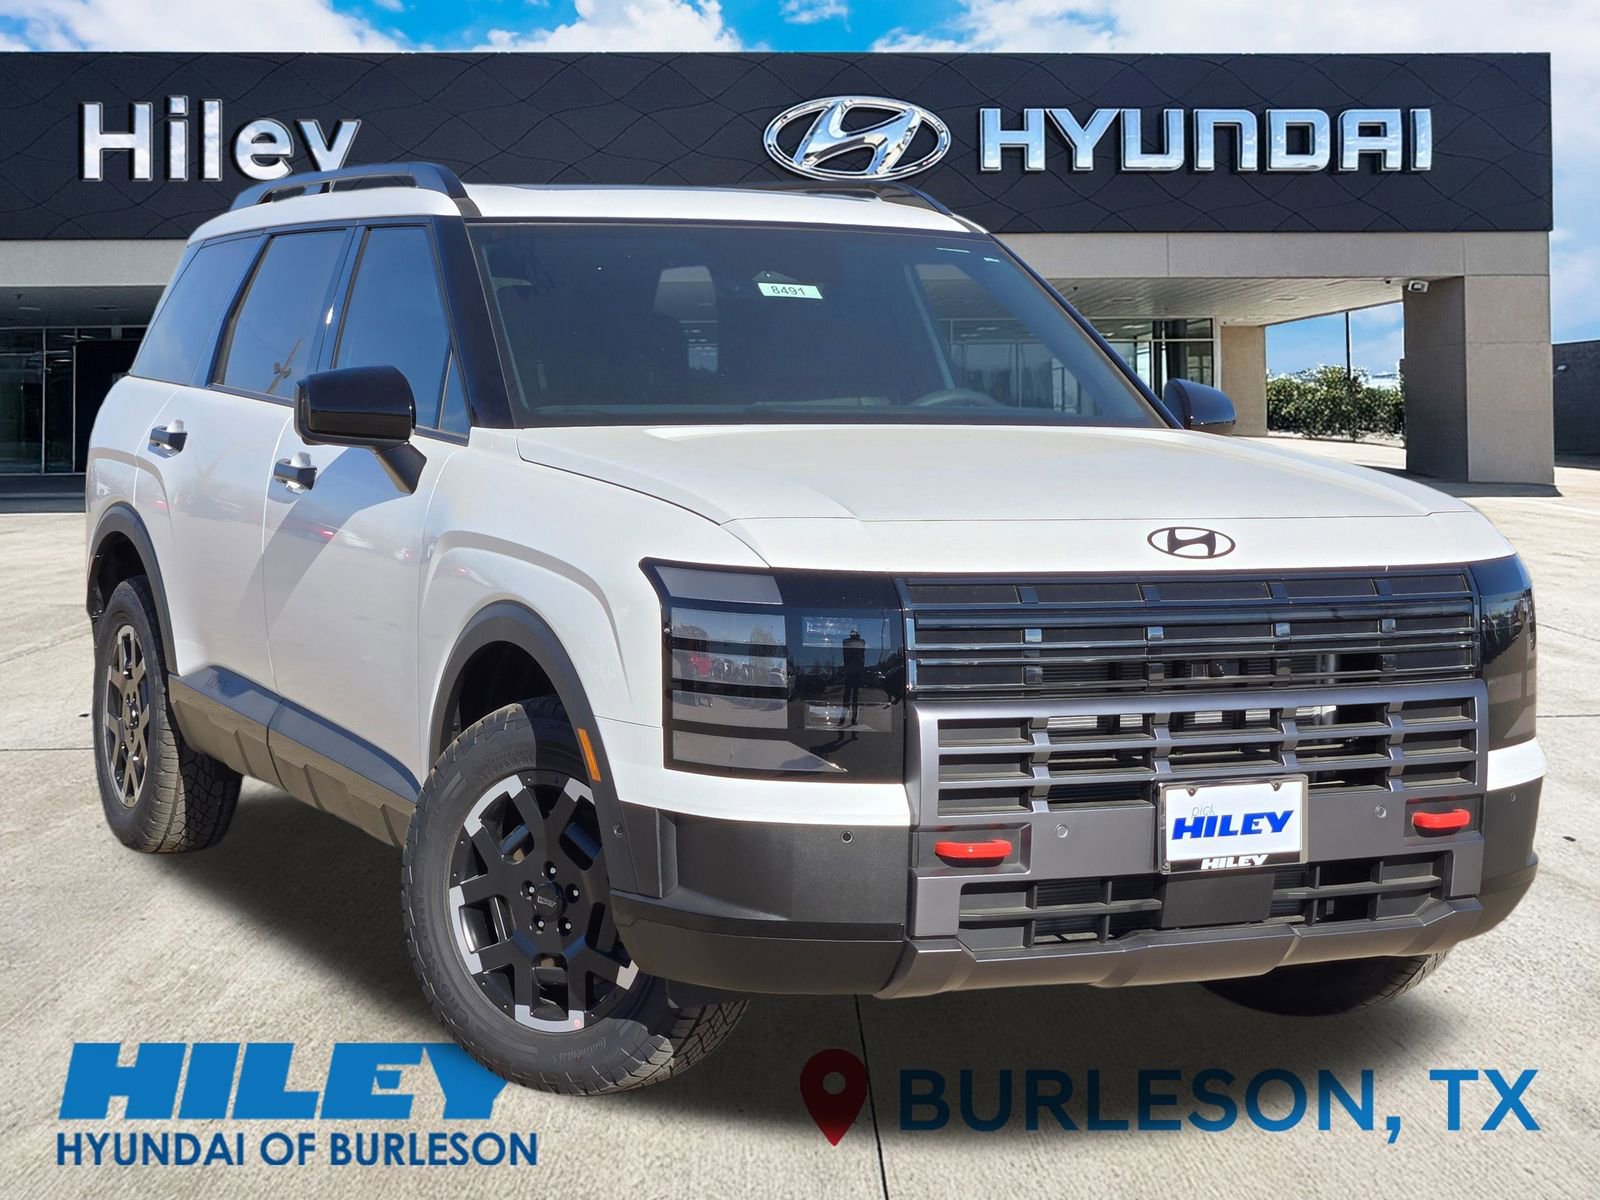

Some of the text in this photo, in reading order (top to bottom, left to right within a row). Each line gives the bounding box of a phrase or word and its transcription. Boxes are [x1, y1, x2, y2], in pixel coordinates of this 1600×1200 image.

[79, 95, 361, 196] Hiley
[979, 108, 1433, 172] HYUNDAI
[770, 285, 806, 296] 8491
[1191, 804, 1216, 818] pick
[1172, 810, 1294, 840] HILEY
[1201, 854, 1268, 870] HILEY
